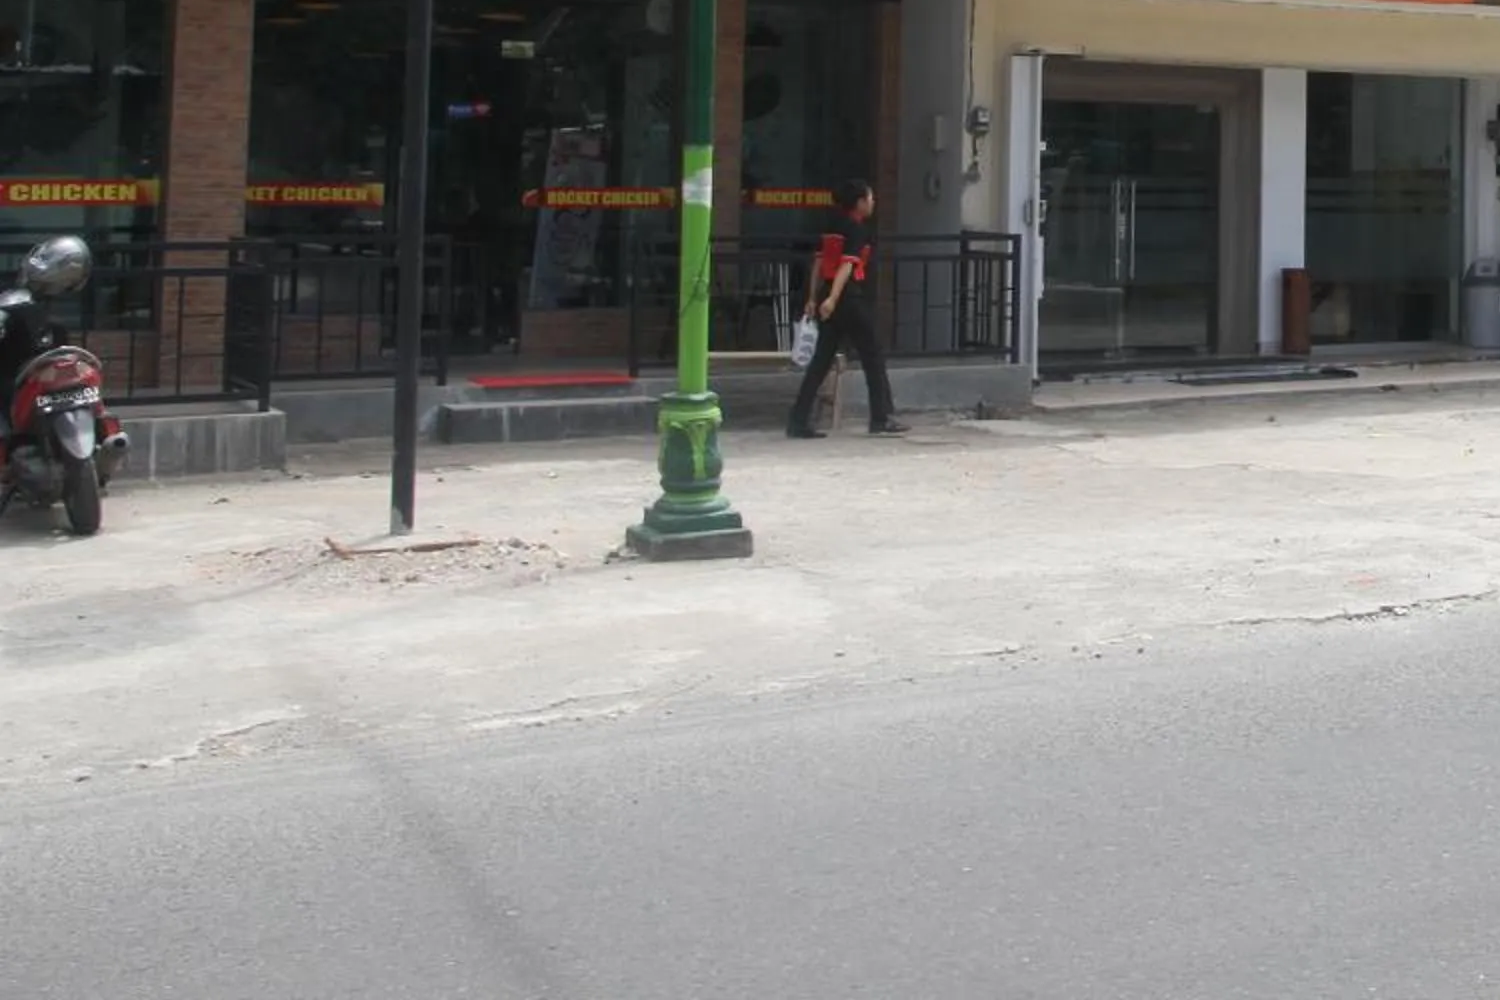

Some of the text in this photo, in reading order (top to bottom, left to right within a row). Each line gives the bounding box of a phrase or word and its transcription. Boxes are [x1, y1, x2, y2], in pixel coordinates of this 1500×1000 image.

[9, 183, 137, 201] CHICKEN
[281, 186, 369, 201] CHICKEN
[547, 190, 660, 205] ROCKET CHICKEN
